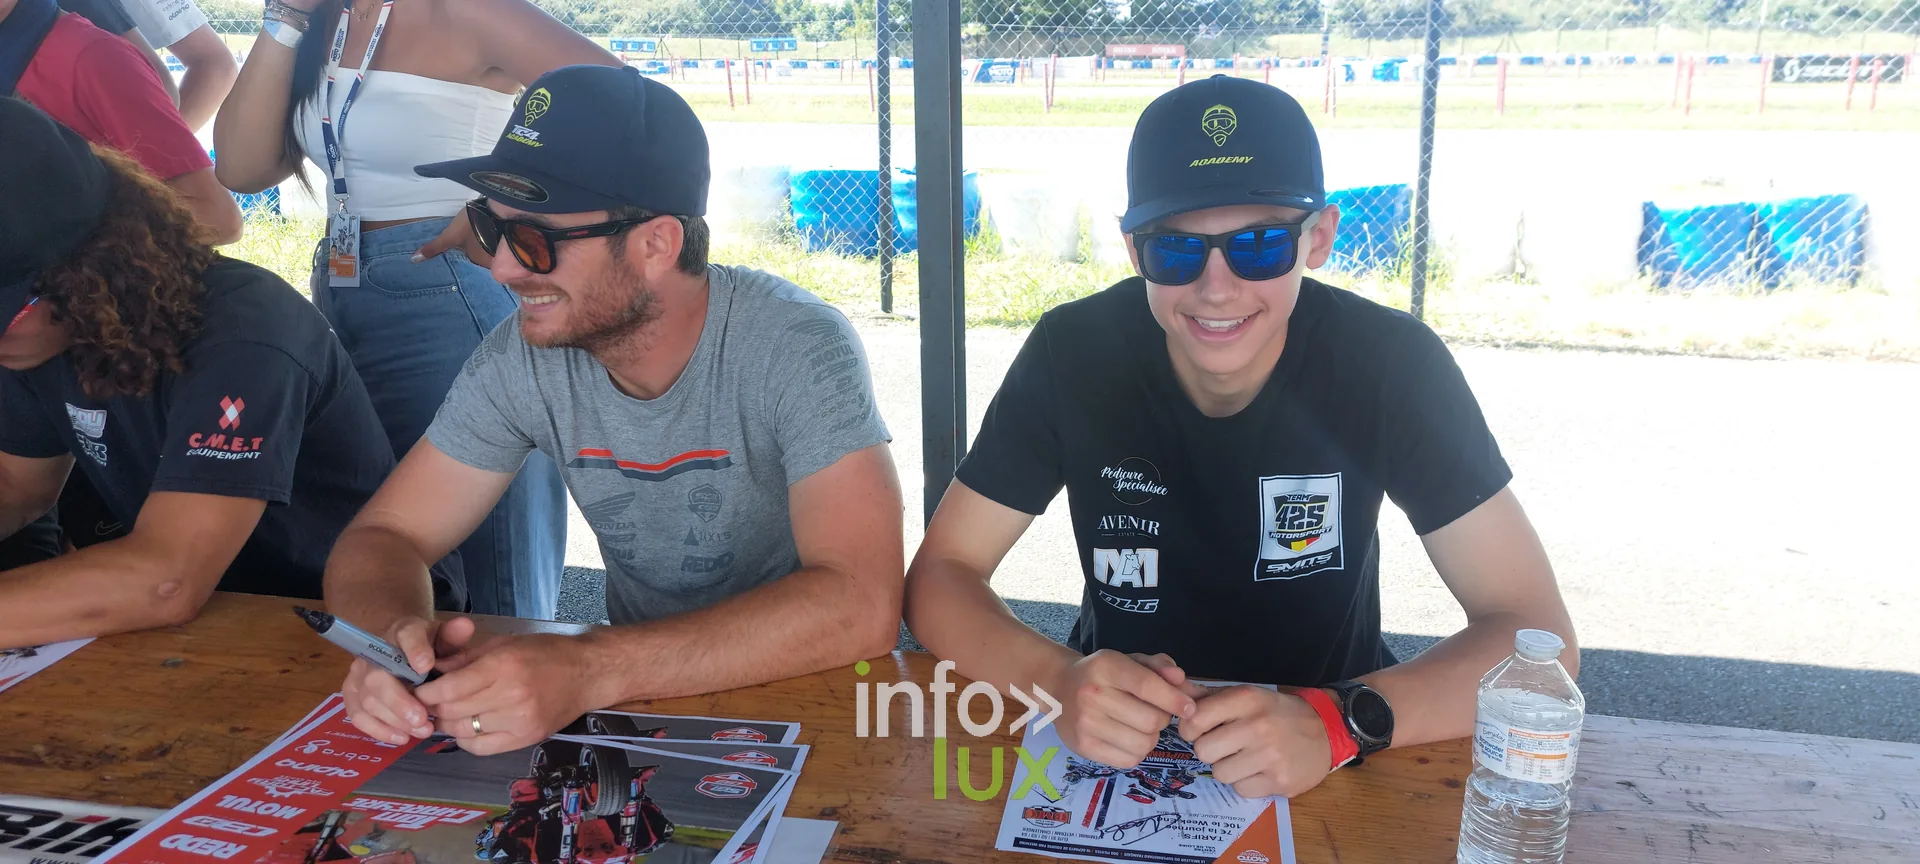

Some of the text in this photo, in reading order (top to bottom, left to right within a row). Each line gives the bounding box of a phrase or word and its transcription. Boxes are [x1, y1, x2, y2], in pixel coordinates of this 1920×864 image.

[188, 432, 264, 452] C.M.E.T
[186, 448, 262, 461] EQUIPEMENT
[1101, 466, 1144, 481] Pédicure
[1113, 477, 1169, 496] Spécialisée
[1287, 493, 1311, 501] TEAM
[1097, 515, 1160, 536] AVENIR
[1275, 502, 1328, 532] 425
[1269, 526, 1332, 539] MOTORSPORT
[1266, 552, 1333, 573] SMITS
[322, 748, 382, 763] cobra
[216, 795, 307, 819] MOTUL
[160, 833, 248, 859] REDD
[1184, 833, 1224, 842] TARIFS
